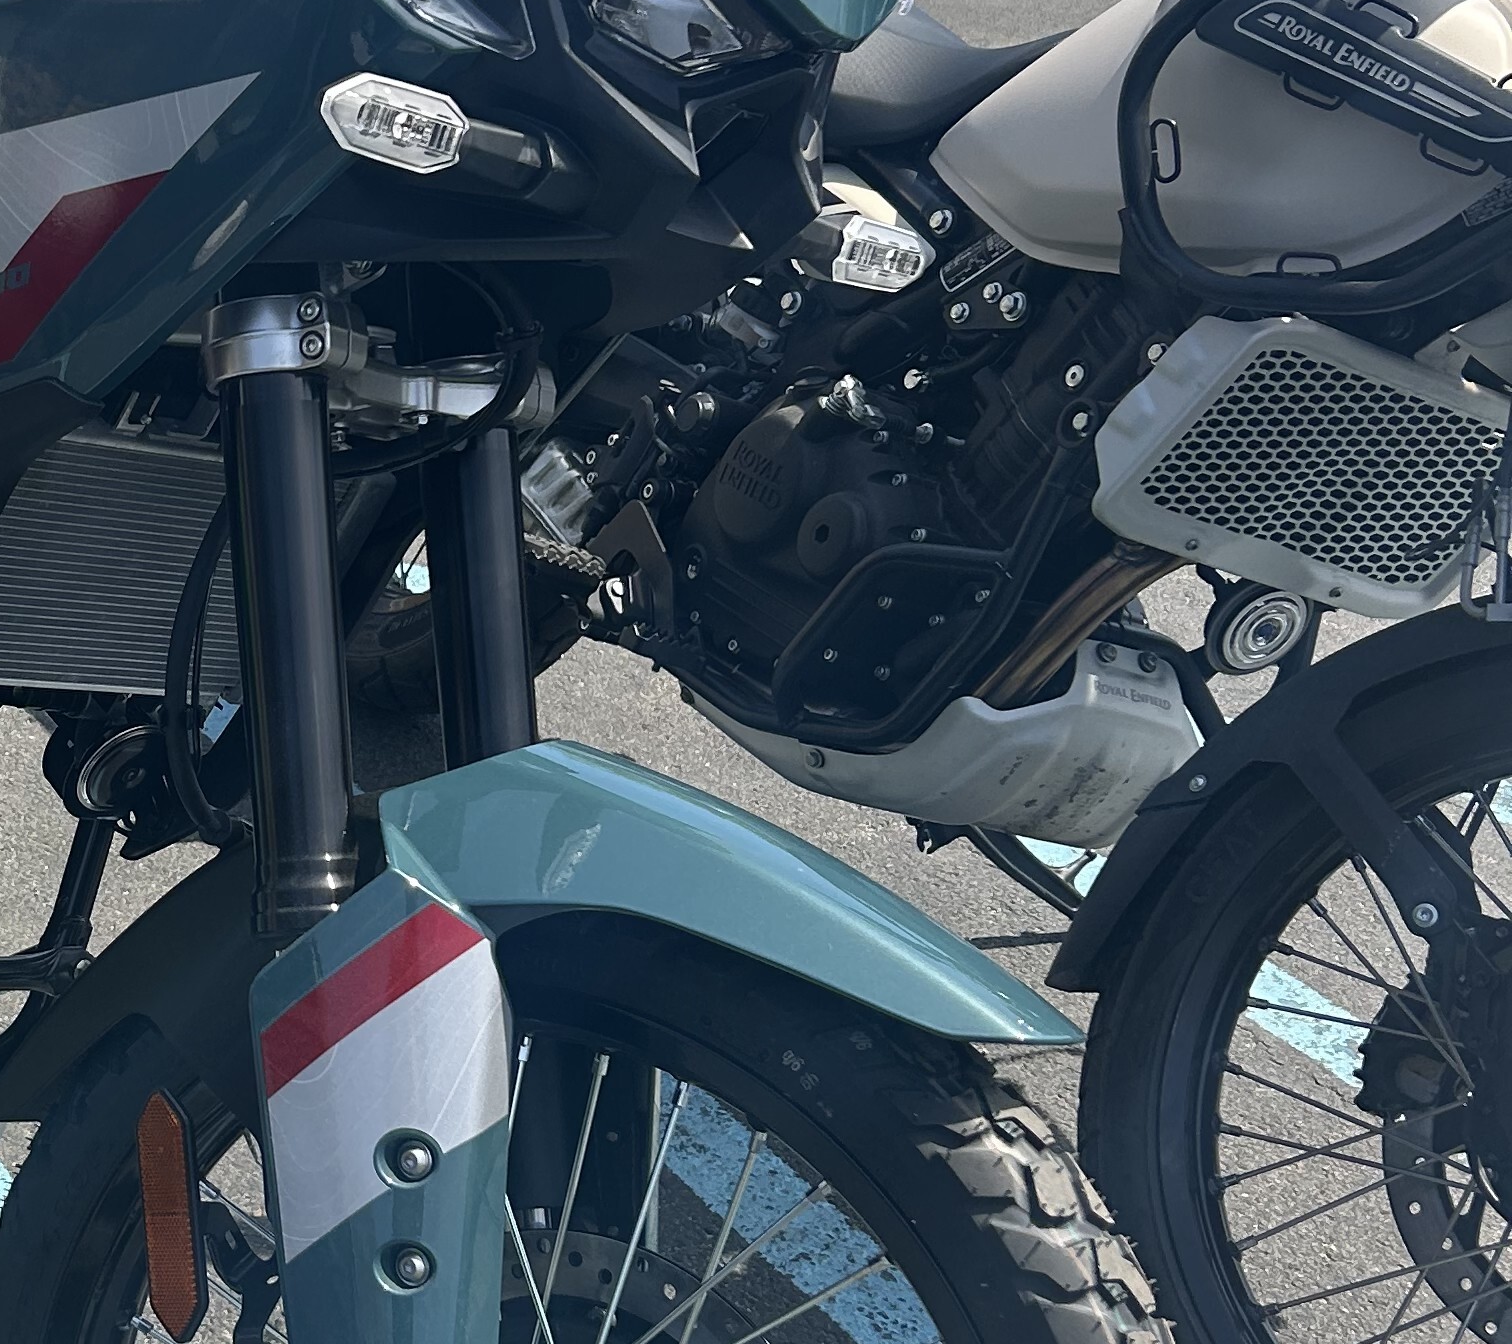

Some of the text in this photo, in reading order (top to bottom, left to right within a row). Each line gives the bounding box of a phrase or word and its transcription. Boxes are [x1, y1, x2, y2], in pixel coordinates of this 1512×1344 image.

[1278, 15, 1411, 92] ROYAL ENFIELD
[1094, 679, 1129, 699] ROYAL
